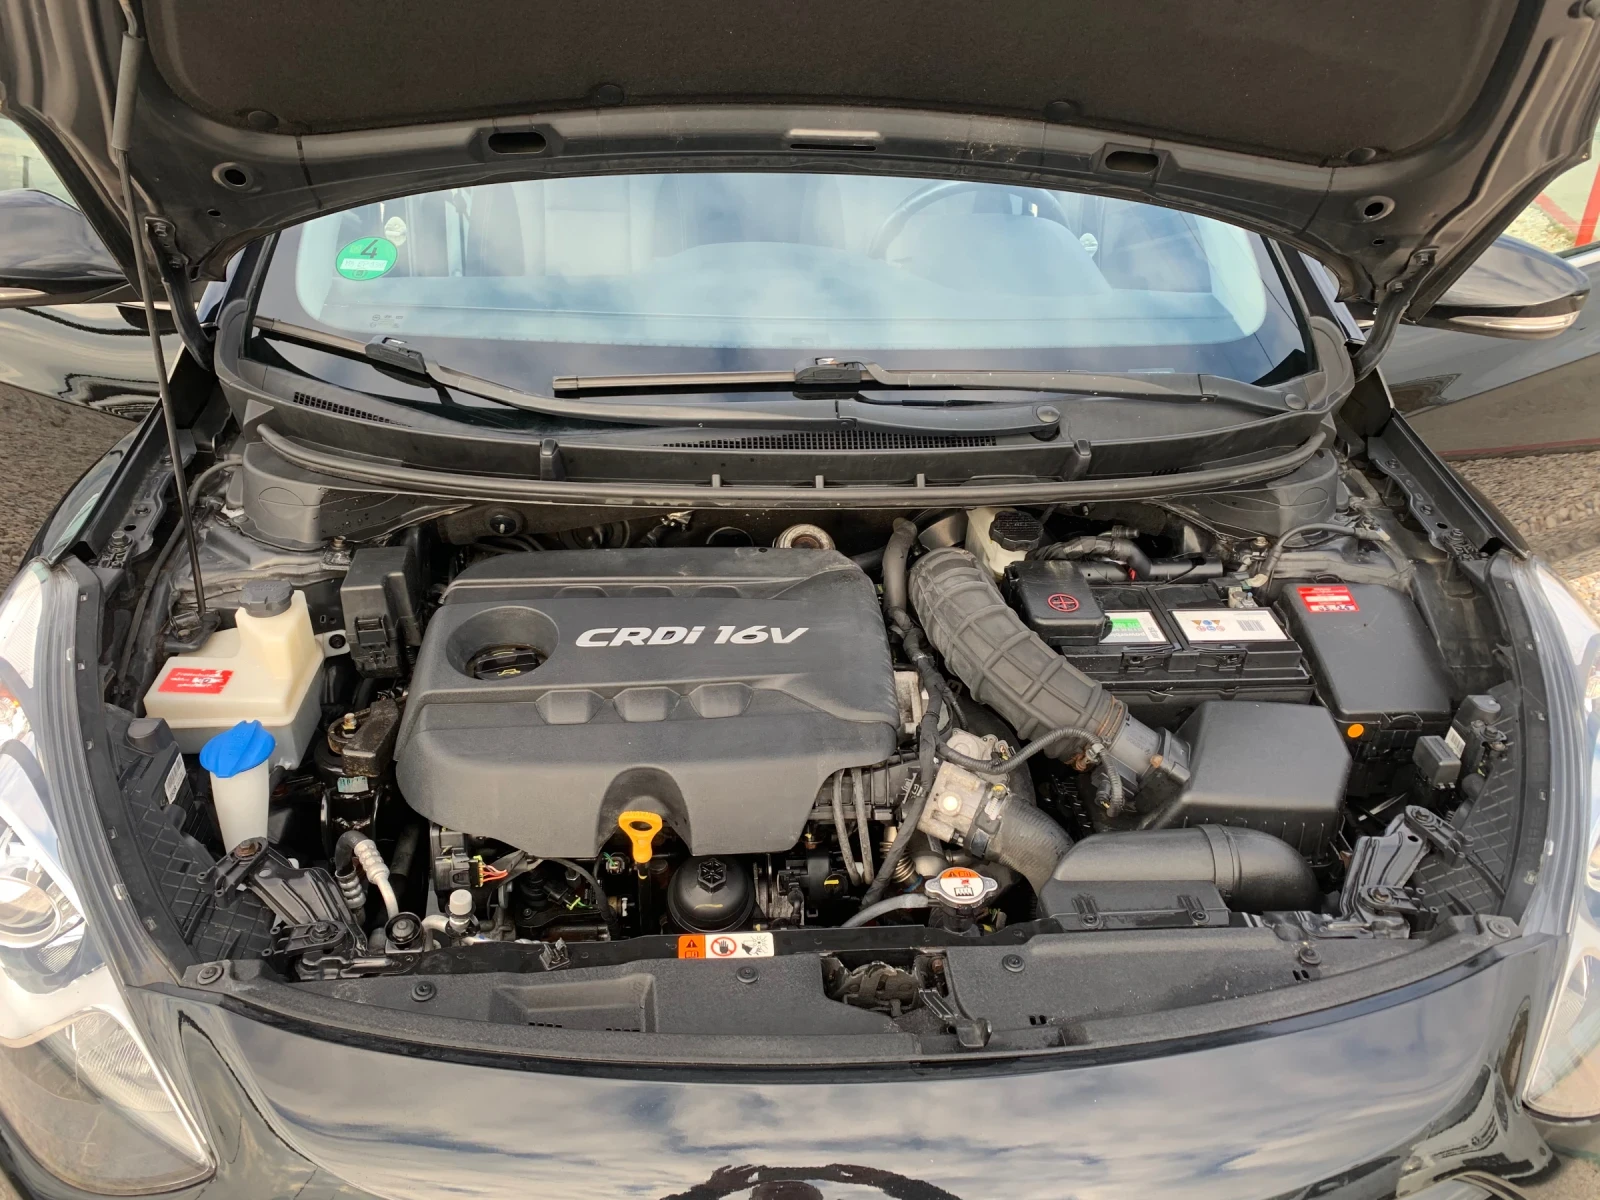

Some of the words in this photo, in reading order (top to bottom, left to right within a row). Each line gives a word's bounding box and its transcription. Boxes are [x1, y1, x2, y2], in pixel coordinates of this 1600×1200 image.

[360, 239, 378, 258] 4
[575, 625, 706, 647] CRDi
[713, 625, 810, 645] 16V
